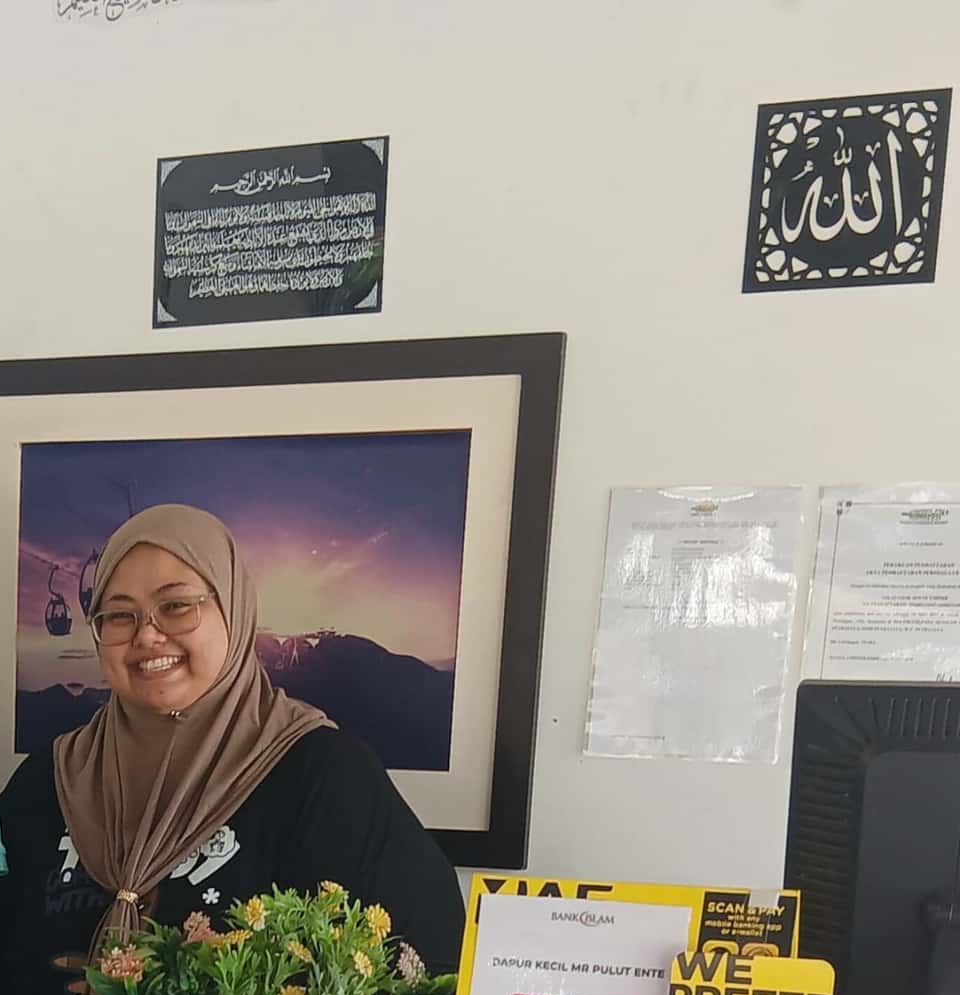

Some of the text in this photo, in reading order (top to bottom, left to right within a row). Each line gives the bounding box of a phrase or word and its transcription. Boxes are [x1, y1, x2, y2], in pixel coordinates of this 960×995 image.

[551, 912, 581, 922] BANK
[707, 902, 745, 914] SCAN
[759, 906, 785, 917] PAY
[492, 957, 665, 979] DAPUR KECIL MR PULUT ENTE
[677, 951, 753, 985] WE
